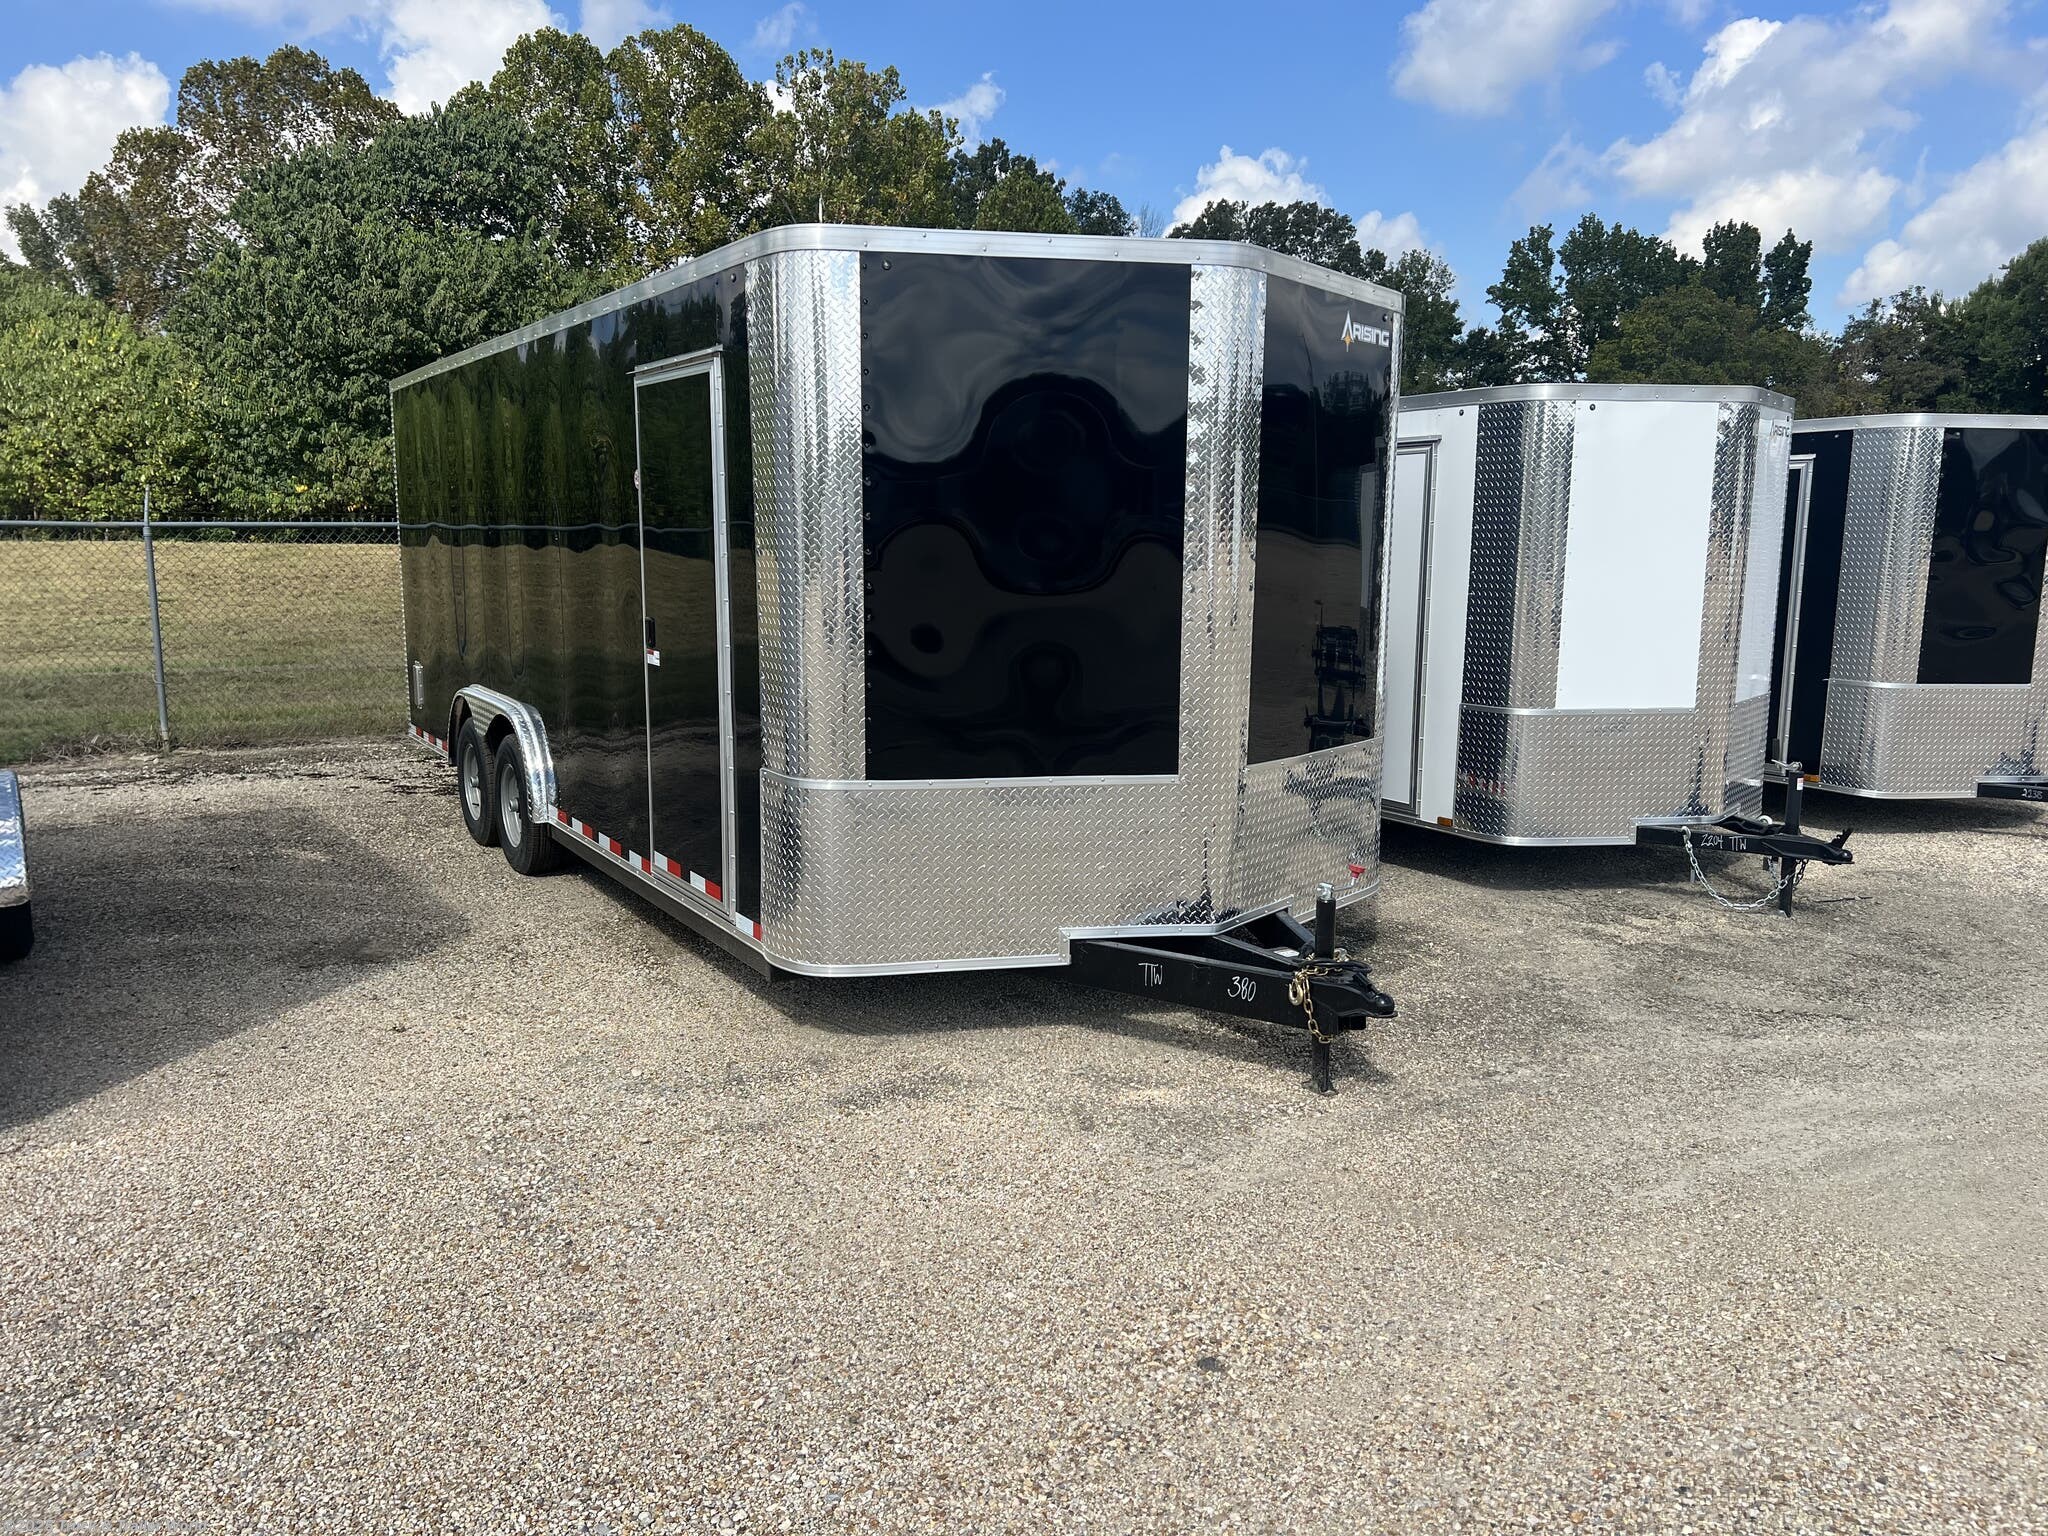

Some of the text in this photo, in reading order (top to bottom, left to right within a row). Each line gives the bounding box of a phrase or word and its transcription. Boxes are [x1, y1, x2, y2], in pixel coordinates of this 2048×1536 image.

[1700, 833, 1747, 851] 2204 TTW
[1138, 962, 1257, 1002] TTW 380
